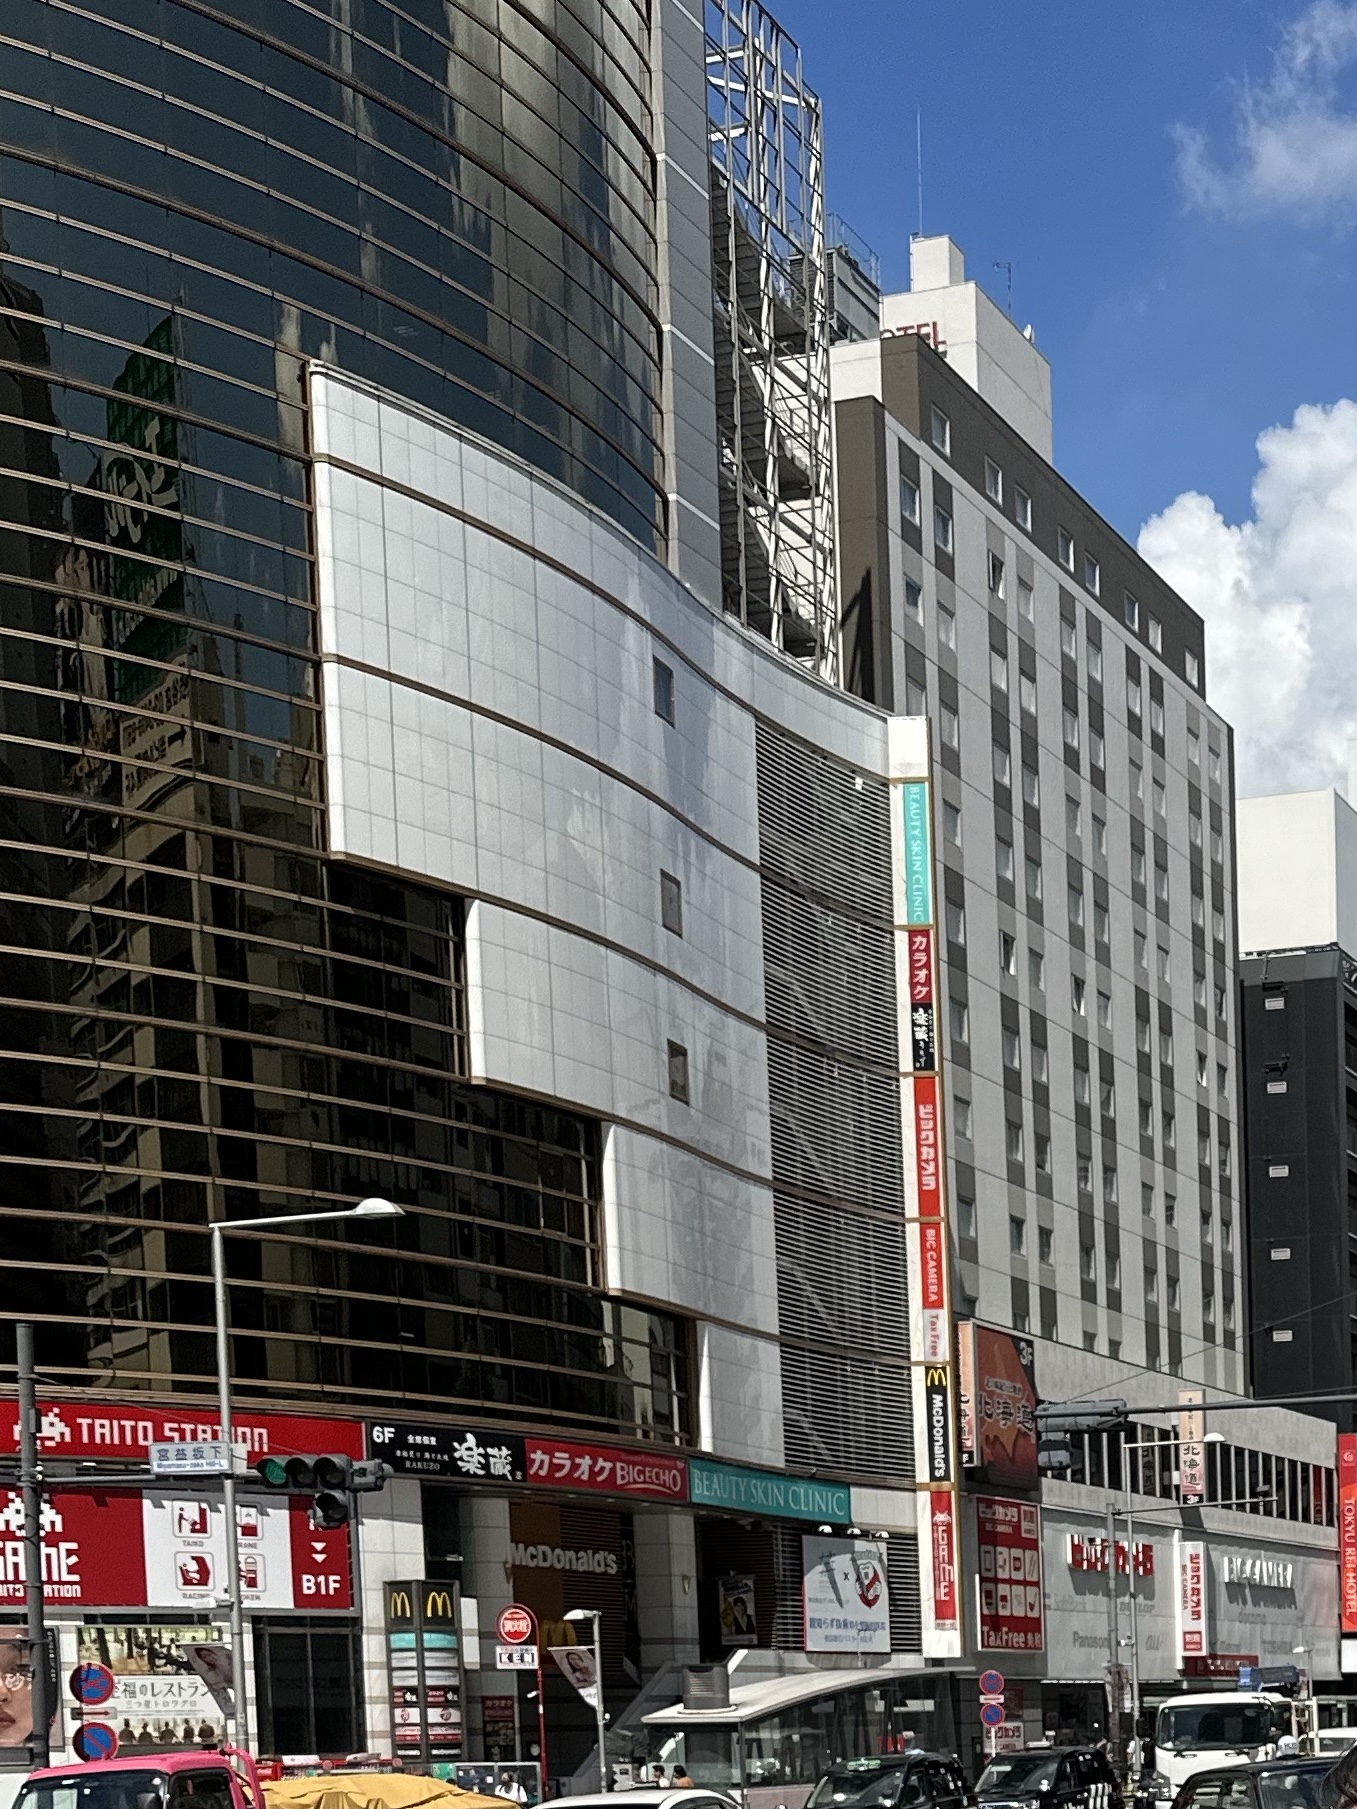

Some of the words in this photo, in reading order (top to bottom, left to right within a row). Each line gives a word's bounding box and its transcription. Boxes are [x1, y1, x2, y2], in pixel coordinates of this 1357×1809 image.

[909, 786, 921, 839] BEAUTY
[911, 839, 923, 872] SKIN
[912, 873, 924, 922] CLINIC
[913, 935, 930, 1000] カラオケ
[926, 1251, 938, 1303] CAMERA
[76, 1418, 153, 1446] TAITO
[372, 1426, 396, 1443] 6F
[931, 1394, 946, 1478] McDonald's
[405, 1460, 440, 1471] RAKUZO
[529, 1449, 613, 1482] カラオケ
[1183, 1445, 1201, 1486] 北海道
[693, 1469, 747, 1500] BEAUTY
[749, 1479, 785, 1507] SKIN
[788, 1486, 845, 1516] CLINIC
[1344, 1496, 1356, 1542] TOKYU
[506, 1542, 619, 1575] McDonald's
[938, 1527, 954, 1600] GAME
[302, 1575, 341, 1596] B1F
[1346, 1565, 1357, 1616] HOTEL
